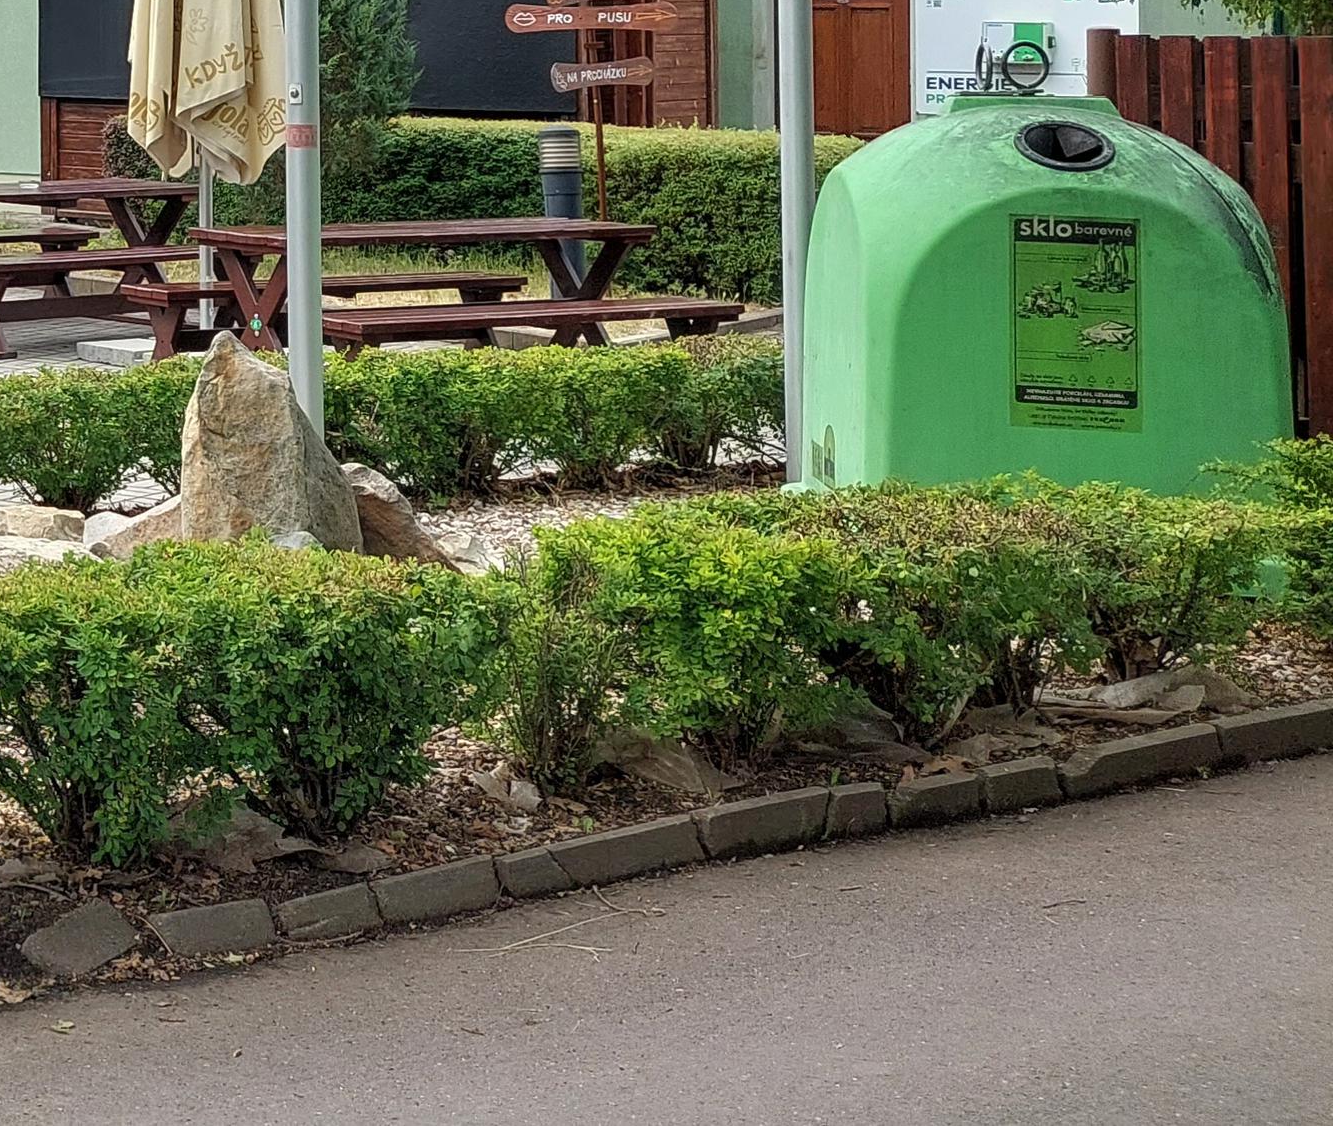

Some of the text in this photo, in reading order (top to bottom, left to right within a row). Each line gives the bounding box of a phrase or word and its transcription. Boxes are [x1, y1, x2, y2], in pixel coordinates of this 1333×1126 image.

[546, 11, 632, 24] PRO PUSU
[184, 42, 244, 89] KDYŽ
[566, 64, 627, 83] NA PROCHÁZKU
[926, 76, 1013, 91] ENERIE
[1019, 215, 1133, 238] sklo barevné
